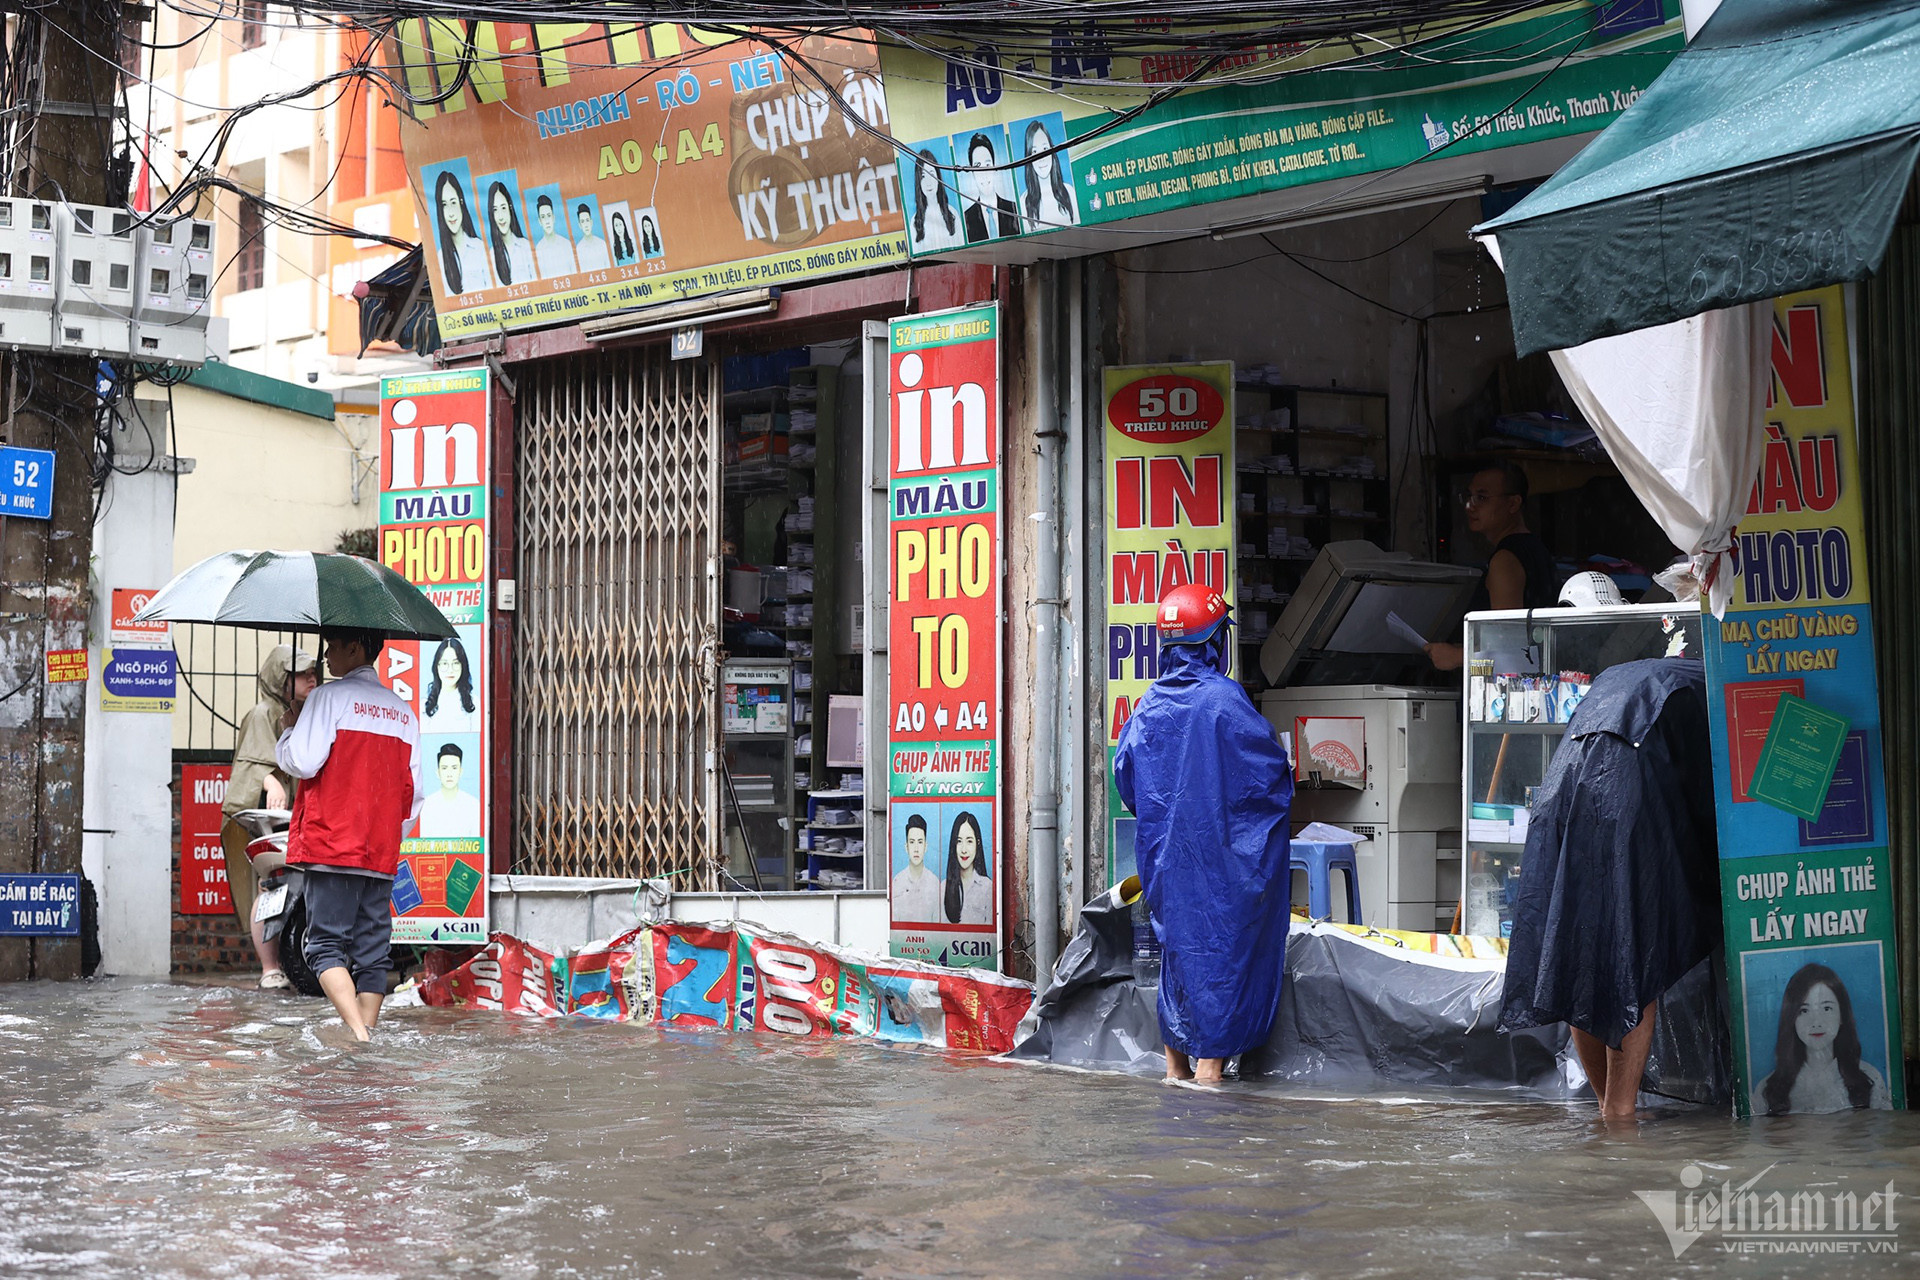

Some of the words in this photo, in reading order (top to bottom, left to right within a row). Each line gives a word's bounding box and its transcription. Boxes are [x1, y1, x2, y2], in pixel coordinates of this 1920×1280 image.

[536, 91, 630, 139] NHANH
[656, 68, 700, 110] RÕ
[729, 49, 786, 94] NÉT
[1474, 115, 1492, 137] 50
[1526, 100, 1566, 128] Khúc,
[1566, 92, 1609, 119] Thanh
[1610, 85, 1646, 111] Xuâ
[746, 89, 829, 160] CHỤP
[598, 139, 643, 180] A0
[676, 122, 724, 165] A4
[1101, 162, 1126, 180] SCAN,
[1126, 158, 1136, 176] ÉP
[1138, 155, 1172, 174] PLASTIC,
[1172, 147, 1195, 166] ĐÓNG
[1239, 133, 1263, 152] ĐÓNG
[1263, 128, 1279, 147] BÌA
[1279, 128, 1295, 146] MẠ
[1294, 122, 1322, 141] VÀNG,
[1321, 116, 1346, 135] ĐÓNG
[1347, 111, 1366, 133] CẶP
[1105, 190, 1115, 207] IN
[1115, 188, 1136, 203] TEM,
[1160, 176, 1191, 196] DECAN,
[1191, 171, 1220, 190] PHONG
[1220, 165, 1232, 185] BÌ,
[1232, 159, 1251, 182] GIẤY
[1252, 159, 1279, 177] KHEN,
[1279, 149, 1329, 173] CATALOGUE,
[1328, 143, 1340, 164] TỜ
[737, 177, 779, 242] KỸ
[787, 157, 898, 234] THUẬT
[501, 308, 513, 320] 52
[515, 300, 533, 317] PHỐ
[564, 294, 589, 309] KHÚC
[597, 293, 610, 304] TX
[618, 288, 633, 301] HÀ
[635, 283, 653, 299] NỘI
[672, 278, 702, 294] SCAN,
[703, 271, 719, 288] TÀI
[721, 268, 745, 285] LIỆU,
[747, 265, 759, 280] ÉP
[761, 259, 806, 279] PLATICS,
[806, 253, 836, 270] ĐÓNG
[837, 247, 858, 265] GÁY
[860, 239, 895, 260] XOẮN,
[677, 325, 698, 351] 52
[896, 326, 912, 347] 52
[953, 319, 990, 338] KHÚC
[387, 379, 403, 396] 52
[446, 376, 482, 391] KHÚC
[1138, 386, 1198, 418] 50
[896, 352, 991, 473] in
[1171, 418, 1209, 431] KHÚC
[388, 399, 480, 490] in
[13, 459, 39, 488] 52
[1745, 422, 1842, 515] ÀU
[13, 493, 35, 509] KHÚC
[394, 490, 473, 522] MÀU
[895, 476, 988, 517] MÀU
[1114, 454, 1224, 530] IN
[384, 523, 484, 583] PHOTO
[896, 522, 991, 603] PHO
[1111, 539, 1228, 606] MÀU
[457, 582, 482, 606] THẺ
[1721, 621, 1754, 648] MẠ
[1756, 613, 1798, 642] CHỮ
[1802, 613, 1858, 638] VÀNG
[144, 660, 167, 674] PHỐ
[911, 612, 969, 689] TO
[1746, 643, 1781, 675] LẤY
[1785, 648, 1838, 672] NGAY
[894, 701, 926, 732] A0
[955, 701, 988, 730] A4
[893, 748, 928, 780] CHỤP
[930, 742, 961, 773] ẢNH
[965, 741, 990, 773] THẺ
[905, 776, 936, 795] LẤY
[937, 781, 985, 795] NGAY
[194, 843, 208, 860] CÓ
[416, 838, 431, 852] BÌA
[452, 837, 480, 852] VÀNG
[0, 880, 26, 901] CẤM
[30, 880, 47, 901] ĐỂ
[50, 883, 75, 901] RÁC
[1737, 871, 1789, 904] CHỤP
[1795, 861, 1836, 895] ẢNH
[1840, 856, 1877, 891] THẺ
[12, 911, 32, 928] TẠI
[35, 908, 60, 925] ĐÂY
[443, 922, 480, 933] scan
[1750, 907, 1795, 943] LẤY
[1804, 908, 1868, 939] NGAY
[952, 940, 991, 956] scan
